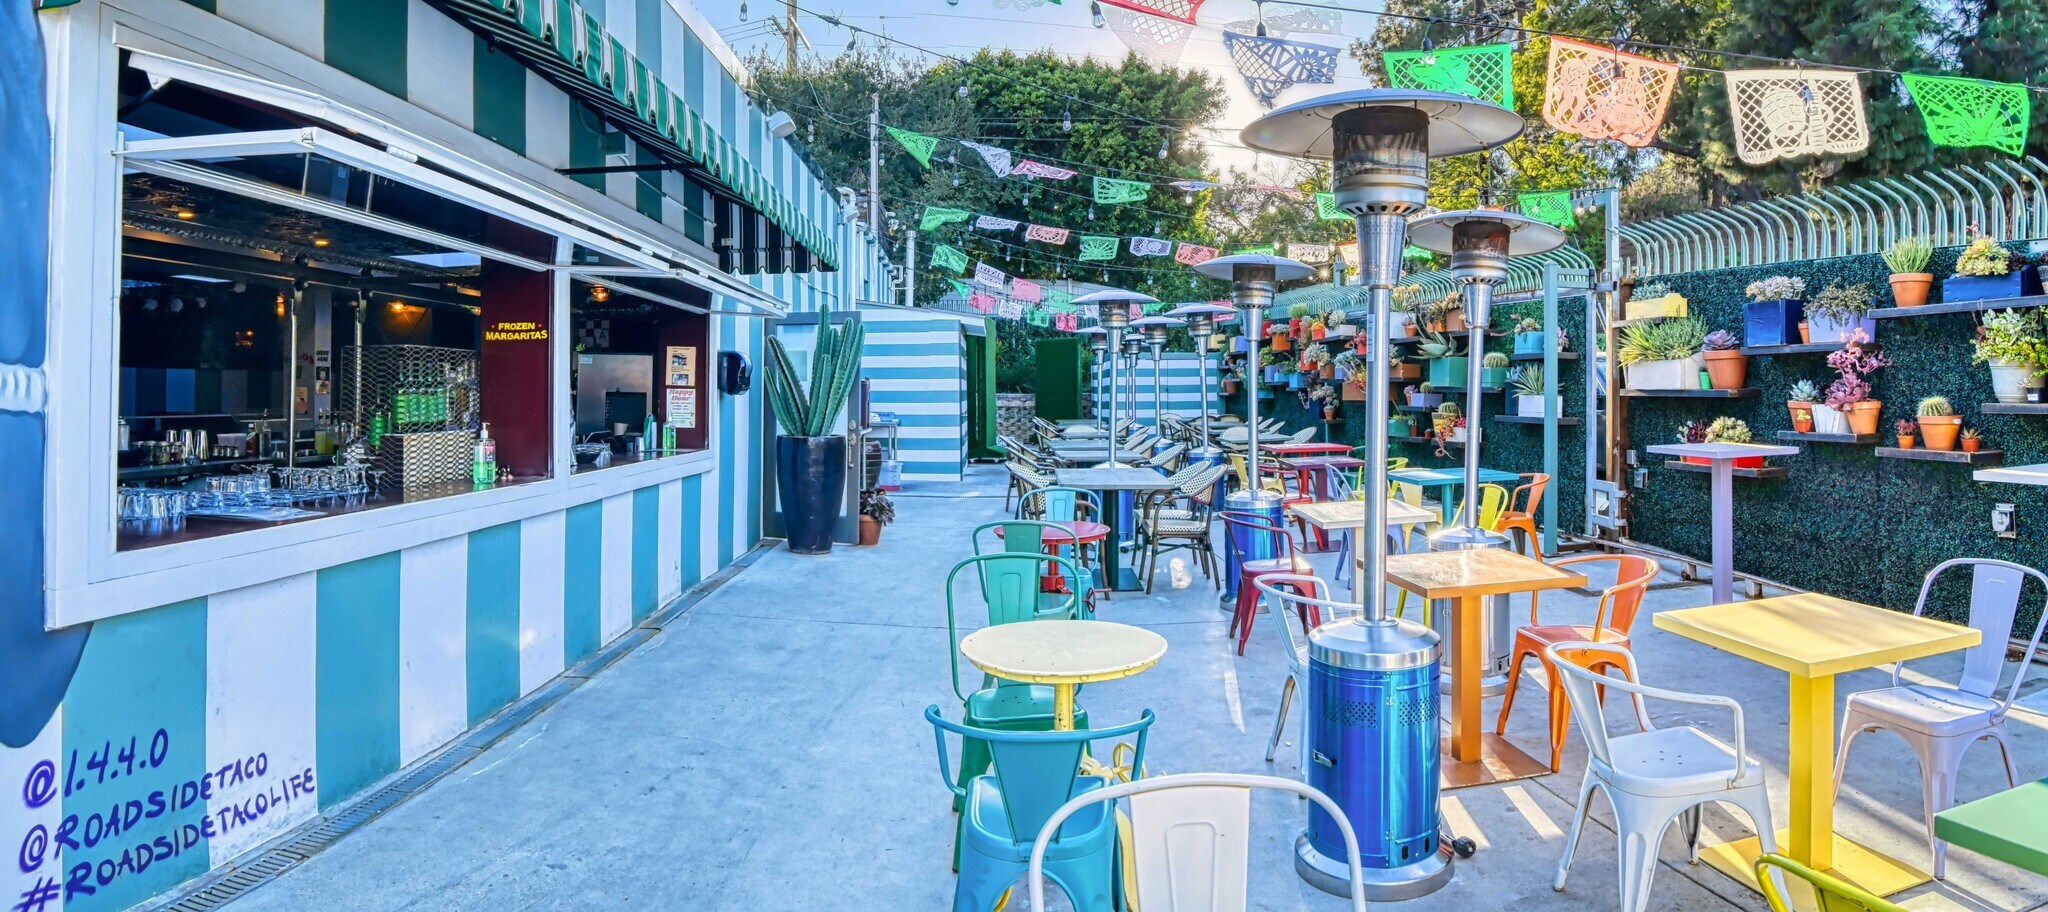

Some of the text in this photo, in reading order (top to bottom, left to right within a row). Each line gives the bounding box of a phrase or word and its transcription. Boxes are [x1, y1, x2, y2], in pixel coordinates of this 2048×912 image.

[485, 330, 548, 340] MARGARITAS
[498, 322, 535, 330] FROZEN
[13, 767, 315, 912] #ROADSIDETACOLIFE
[19, 752, 268, 873] @ROADSIDETACO
